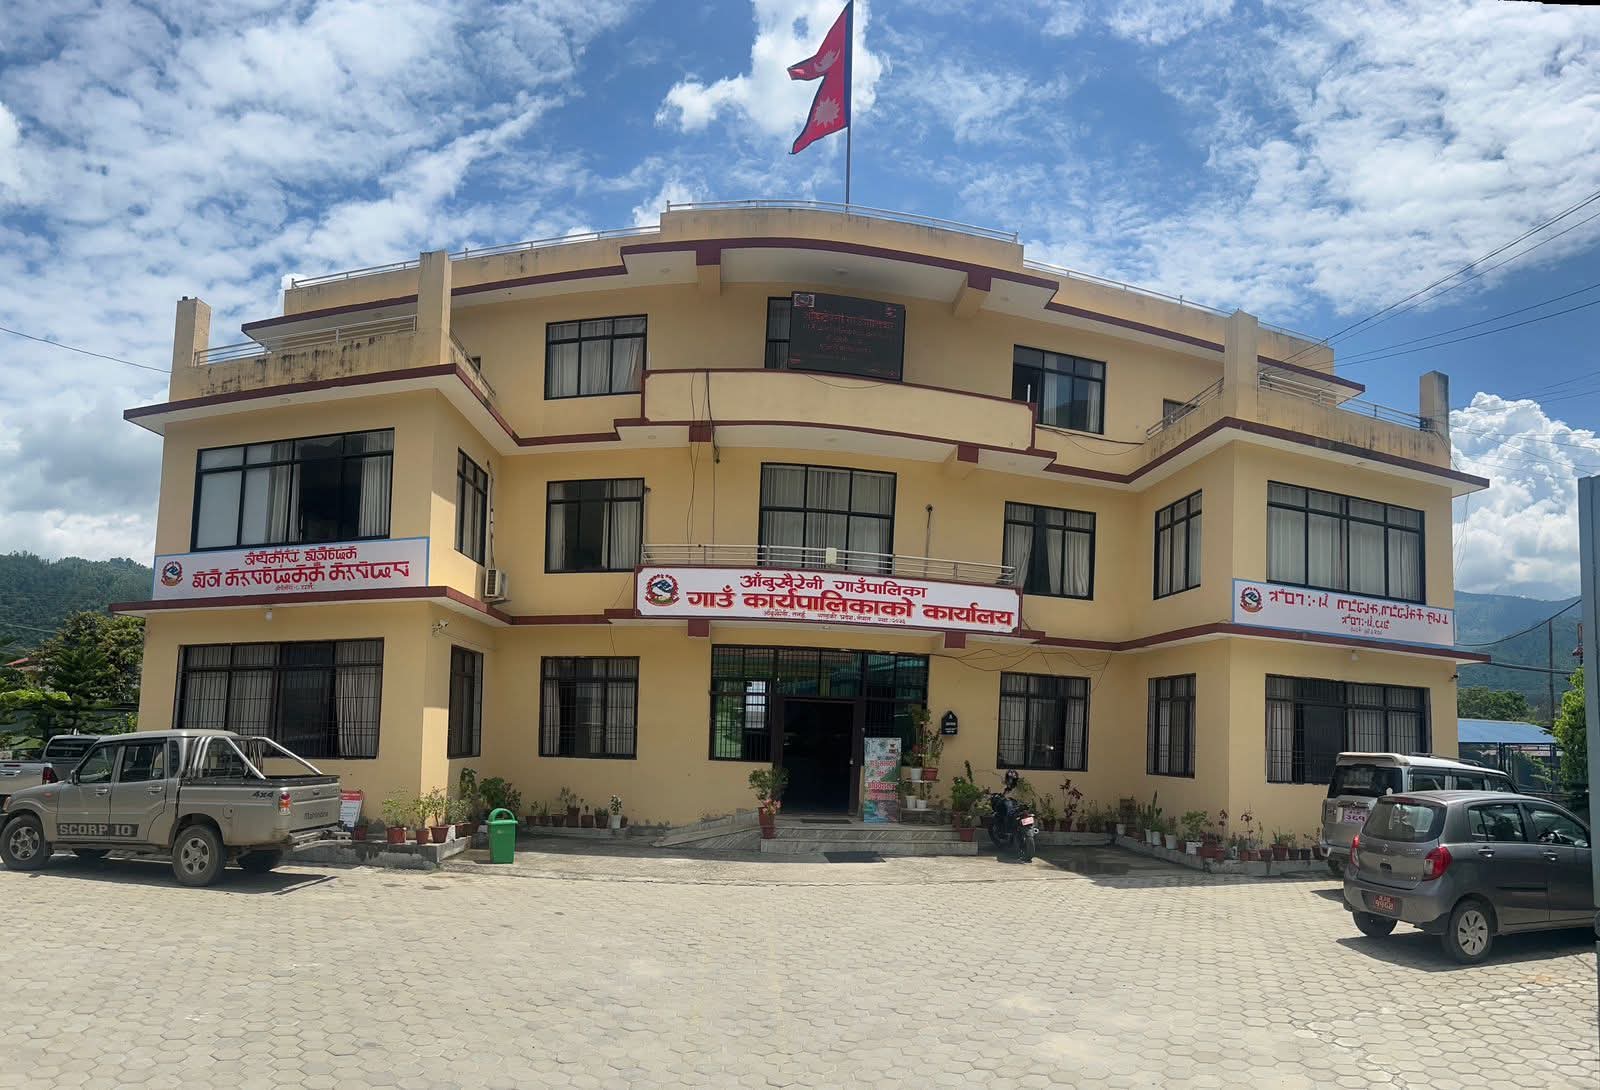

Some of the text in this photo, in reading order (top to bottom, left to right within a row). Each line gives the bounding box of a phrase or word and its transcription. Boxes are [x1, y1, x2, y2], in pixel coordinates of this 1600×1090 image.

[739, 572, 928, 598] आँबुखैरेनी गाउँपालिका
[686, 585, 1013, 626] गाउँ कार्यपालिकाको कार्यालय
